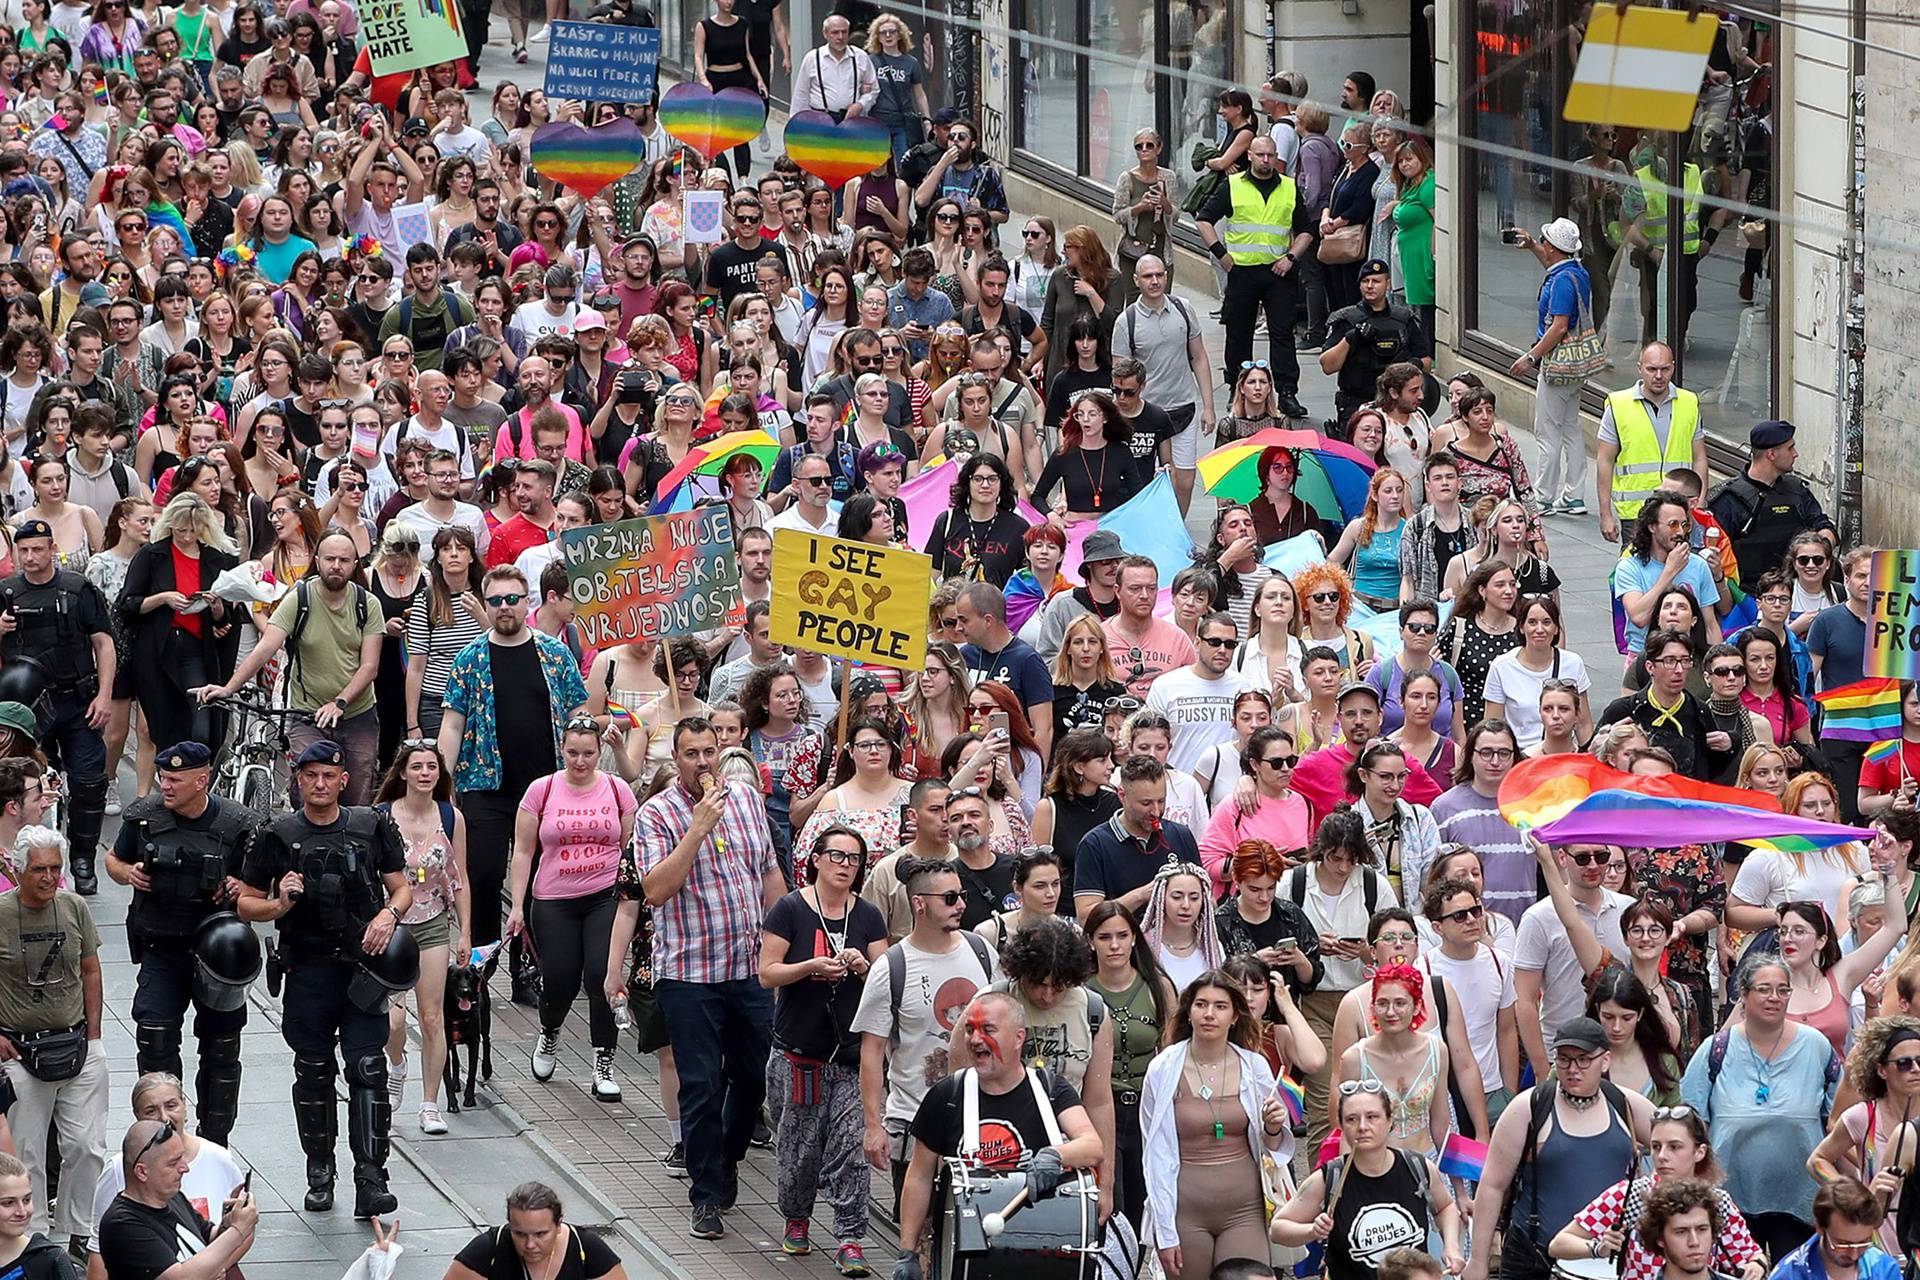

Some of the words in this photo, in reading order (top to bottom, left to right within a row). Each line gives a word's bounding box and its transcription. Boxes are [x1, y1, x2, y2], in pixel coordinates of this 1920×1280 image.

[358, 2, 406, 23] LOVE
[364, 20, 408, 41] LESS
[610, 31, 625, 44] JE
[369, 37, 413, 60] HATE
[549, 64, 565, 77] NA
[568, 67, 598, 78] ULICI
[603, 68, 639, 84] PEDER
[643, 74, 652, 86] A
[547, 83, 555, 94] U
[726, 262, 759, 277] PANT
[740, 273, 760, 284] CIT
[1557, 345, 1591, 360] PARIS
[758, 414, 774, 427] oid
[1129, 438, 1155, 447] DAD
[566, 526, 655, 566] MRŽNJA
[669, 511, 733, 551] NIJE
[946, 540, 1009, 559] QEN
[809, 539, 818, 564] I
[828, 544, 886, 579] SEE
[572, 555, 728, 605] OBITELJSKA
[798, 569, 892, 621] GAY
[576, 584, 739, 646] VRIJEDNOST
[797, 610, 910, 661] PEOPLE
[1145, 650, 1173, 664] ZONE
[1068, 700, 1103, 717] POWRED
[1177, 707, 1216, 723] PUSSY
[1220, 706, 1233, 721] RI
[557, 808, 597, 817] pussy
[921, 975, 932, 1006] おいしい
[979, 1139, 1004, 1151] RUM
[1365, 1222, 1395, 1237] DRUM
[1377, 1227, 1407, 1243] BIJES
